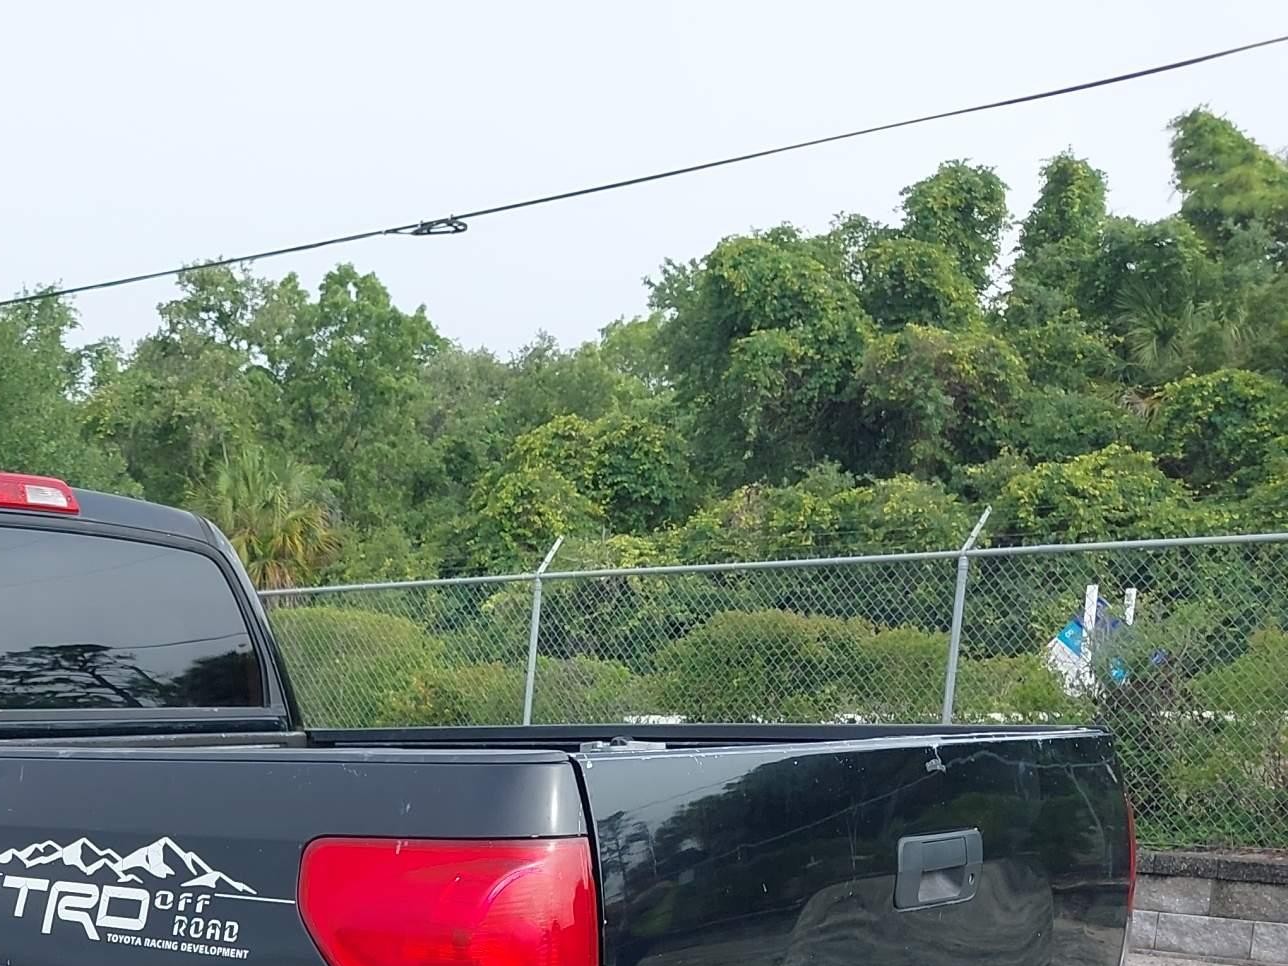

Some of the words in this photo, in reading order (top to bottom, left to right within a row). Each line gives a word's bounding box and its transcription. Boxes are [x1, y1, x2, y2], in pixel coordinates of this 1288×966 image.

[3, 875, 150, 940] TRD
[154, 890, 211, 913] OFF
[172, 915, 239, 942] ROAD
[106, 933, 142, 946] TOYOTA
[143, 938, 178, 951] RACING
[180, 942, 250, 960] DEVELOPMENT
